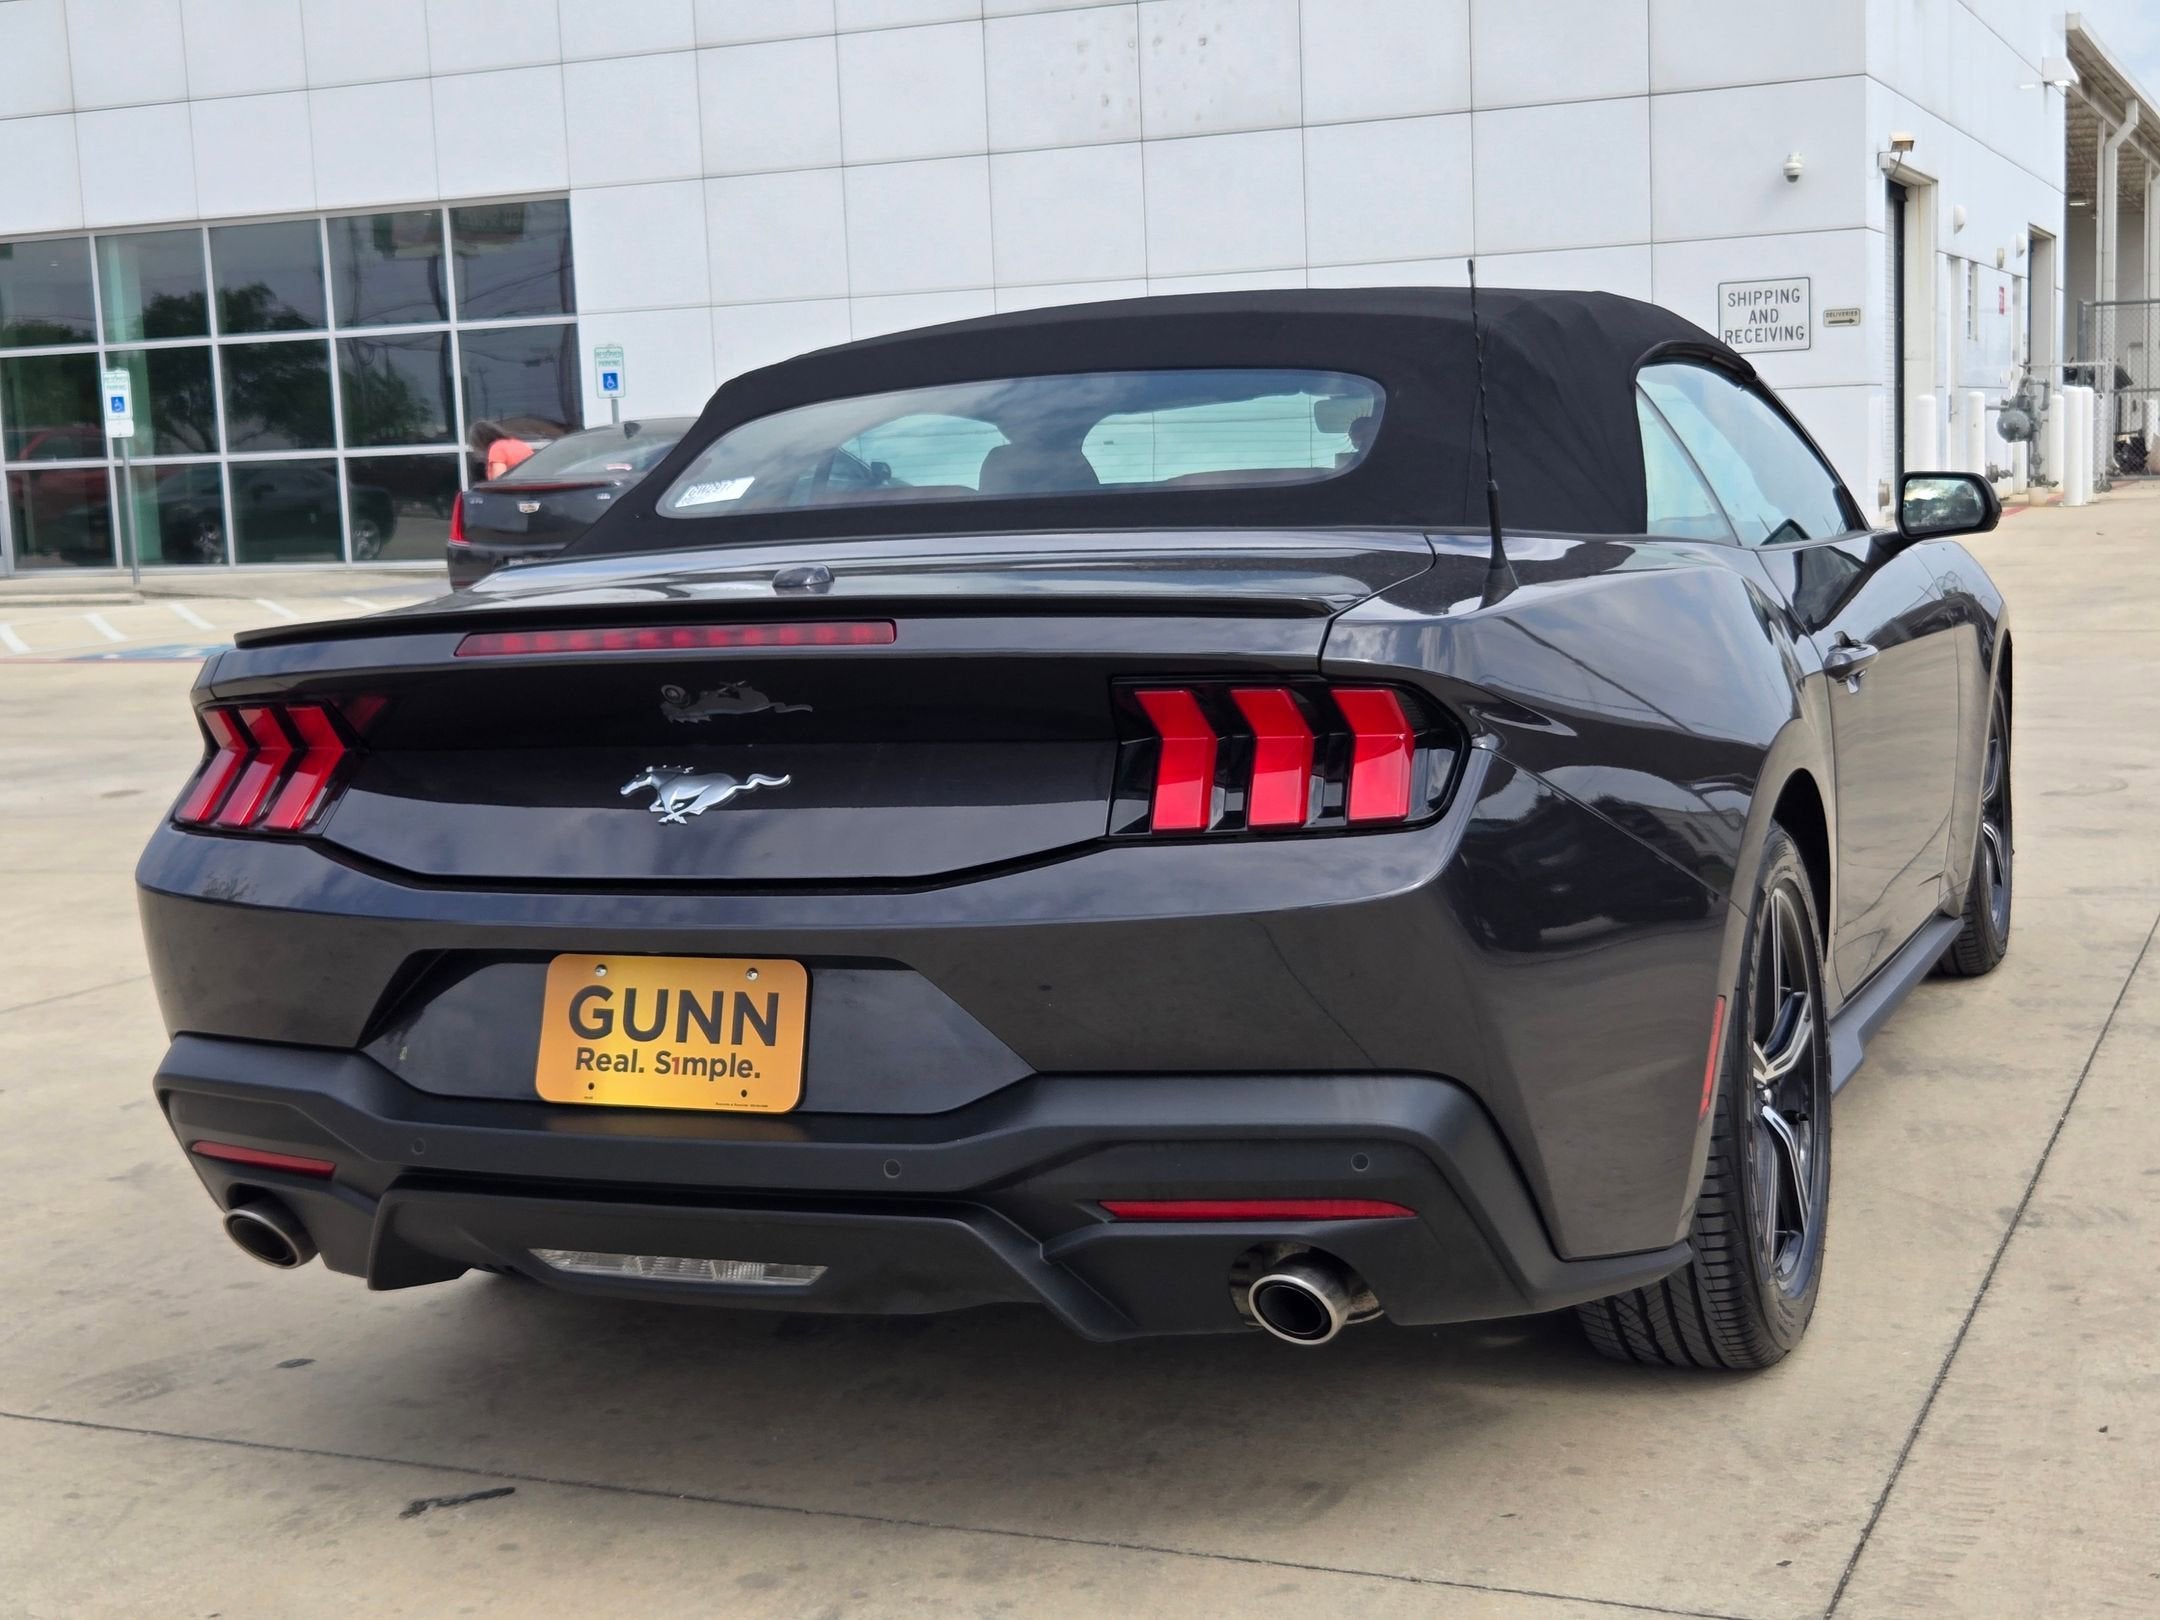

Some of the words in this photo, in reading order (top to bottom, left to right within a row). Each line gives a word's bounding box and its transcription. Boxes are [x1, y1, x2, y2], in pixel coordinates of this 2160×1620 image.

[1727, 288, 1800, 307] SHIPPING
[1748, 308, 1779, 325] AND
[1825, 310, 1858, 318] DELIVERIES
[1724, 325, 1805, 345] RECEIVING
[568, 984, 780, 1047] GUNN
[575, 1047, 645, 1073] Real.
